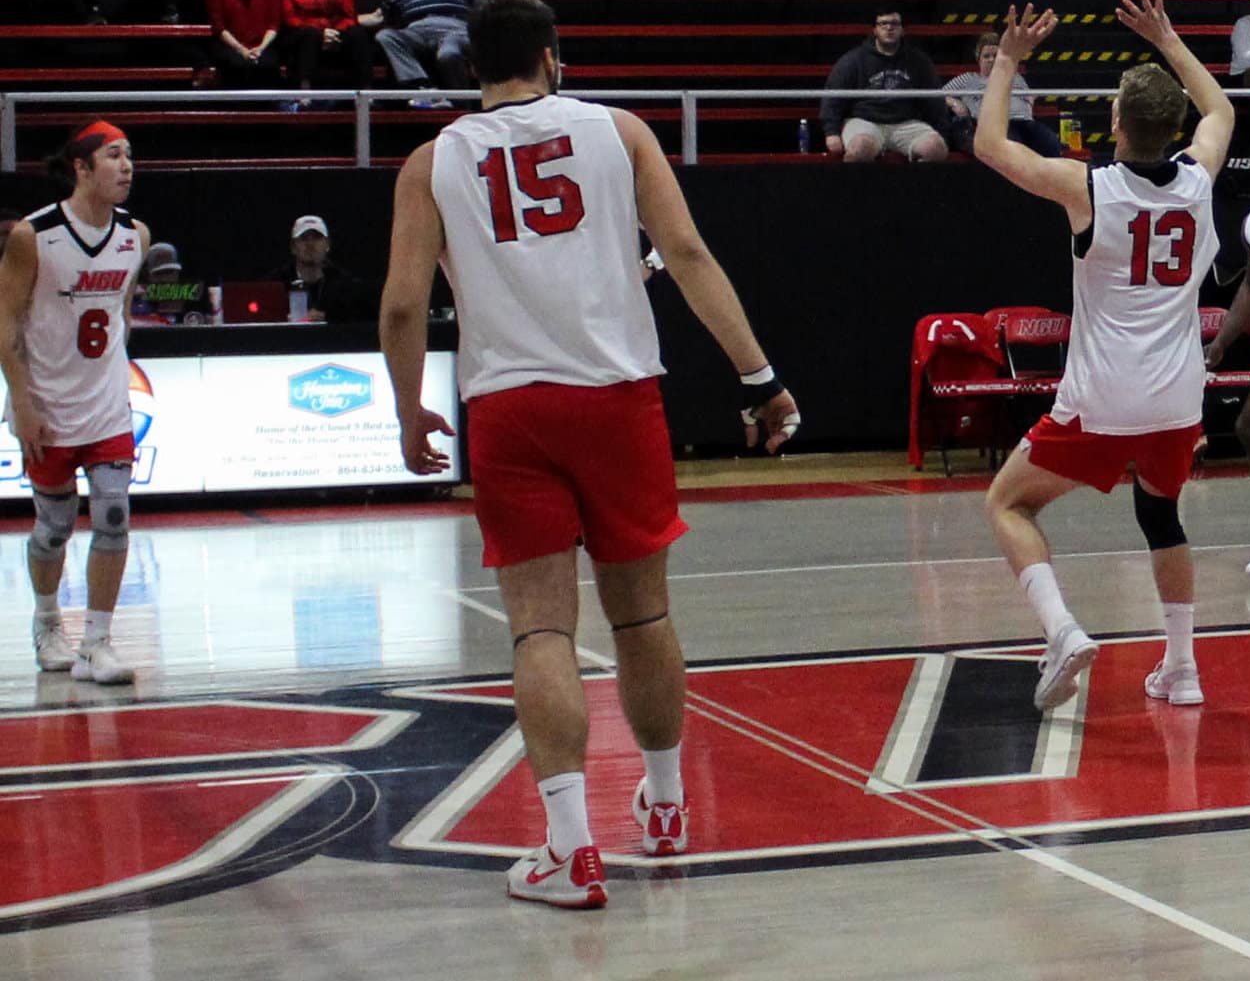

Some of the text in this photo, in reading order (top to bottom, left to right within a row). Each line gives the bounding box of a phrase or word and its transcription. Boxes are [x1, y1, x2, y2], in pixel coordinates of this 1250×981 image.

[477, 134, 585, 244] 15
[1127, 209, 1197, 286] 13
[74, 268, 129, 292] NGU
[77, 307, 110, 359] 6
[1015, 317, 1067, 337] NGU
